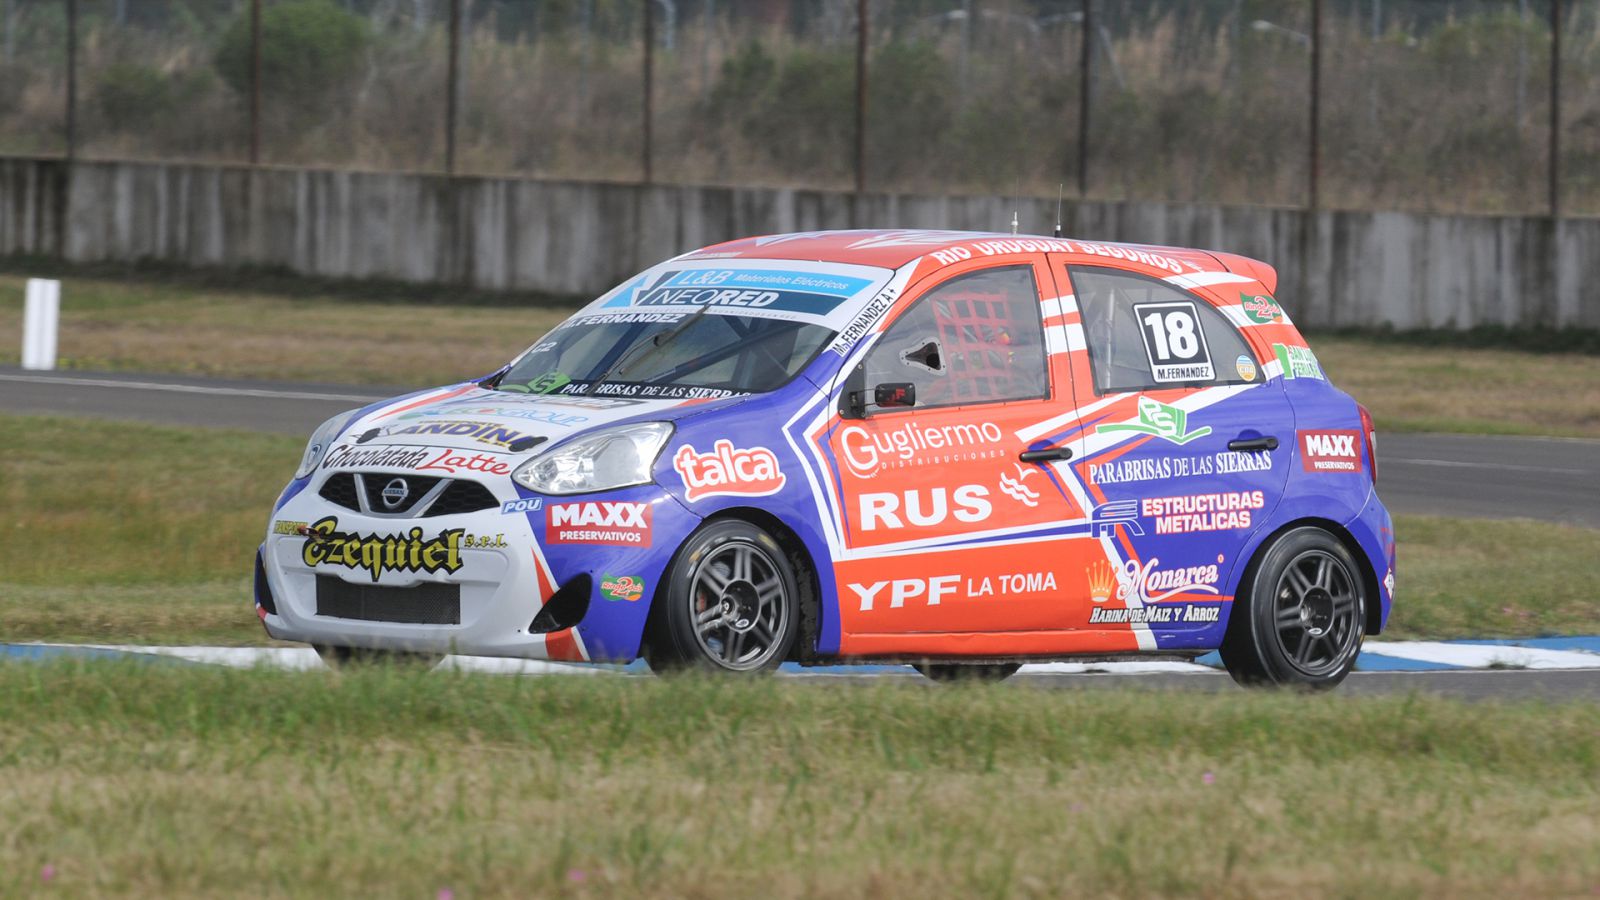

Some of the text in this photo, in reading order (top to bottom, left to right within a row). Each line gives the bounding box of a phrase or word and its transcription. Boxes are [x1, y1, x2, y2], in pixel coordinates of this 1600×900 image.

[929, 240, 1182, 273] RIO URUGUAY SEGUROS
[678, 270, 734, 285] L&B
[651, 288, 780, 307] NEORED
[1144, 311, 1199, 360] 18
[1157, 366, 1210, 380] M.FERNANDEZ
[640, 386, 659, 396] DE
[660, 386, 686, 397] LAS
[841, 421, 1002, 471] Gugliermo
[1305, 434, 1356, 457] MAXX
[415, 448, 512, 475] Latte
[679, 443, 778, 489] talca
[881, 450, 1006, 470] DISTRIBUCIONES
[1088, 450, 1273, 485] PARABRISAS DE LAS SIERRAS
[503, 499, 541, 513] POU
[551, 501, 648, 529] MAXX
[858, 484, 993, 531] RUS
[1142, 490, 1265, 517] ESTRUCTURAS
[1155, 510, 1251, 535] METALICAS
[302, 515, 465, 582] Ezequiel
[559, 530, 642, 543] PRESERVATIVOS
[846, 571, 1057, 611] YPF LA TOMA
[1116, 557, 1219, 603] Monarca
[1174, 607, 1183, 621] Y
